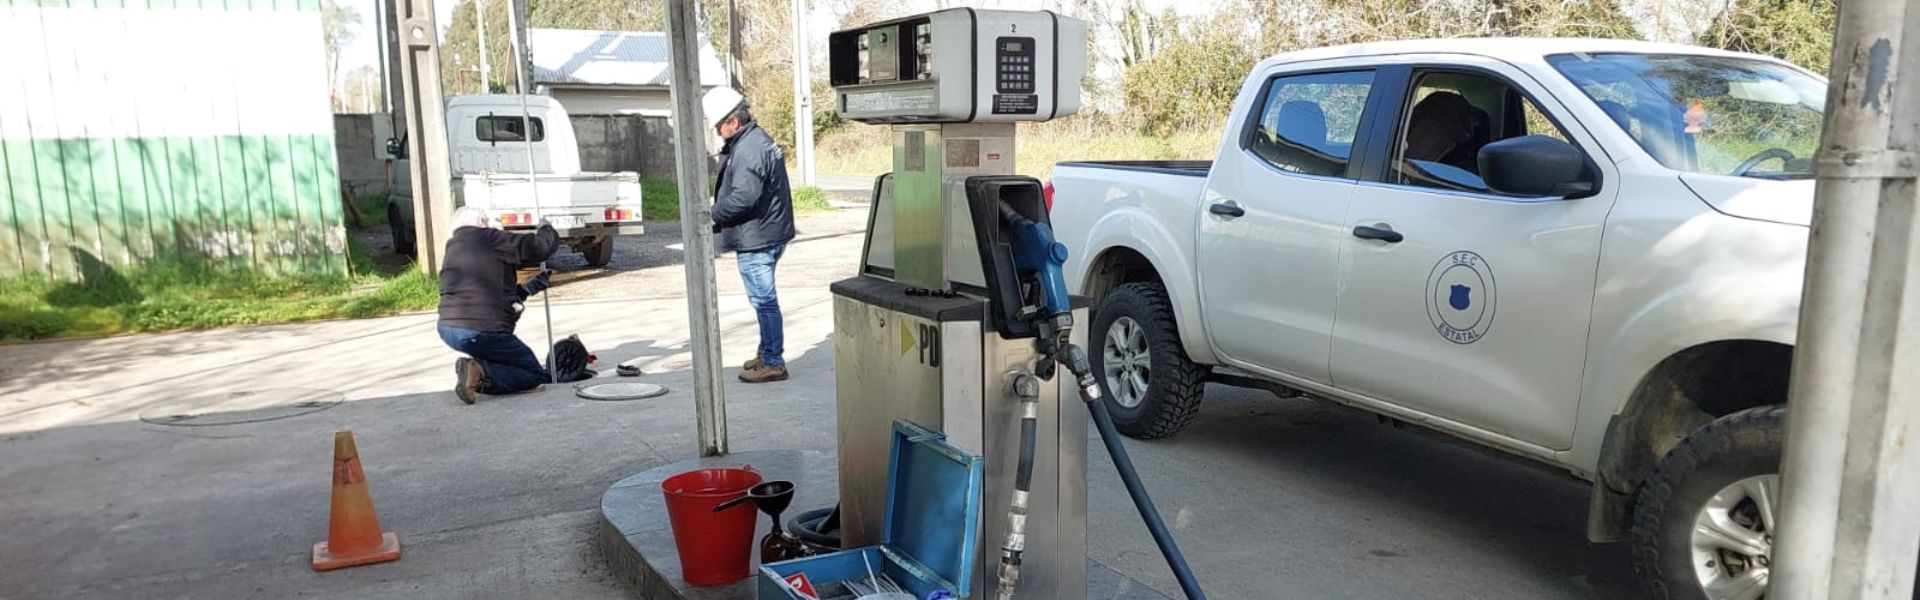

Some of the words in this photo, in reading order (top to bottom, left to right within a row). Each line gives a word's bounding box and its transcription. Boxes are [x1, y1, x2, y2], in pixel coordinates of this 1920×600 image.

[1011, 23, 1017, 33] 2
[1438, 322, 1480, 341] ESTATAL
[919, 322, 939, 368] PD
